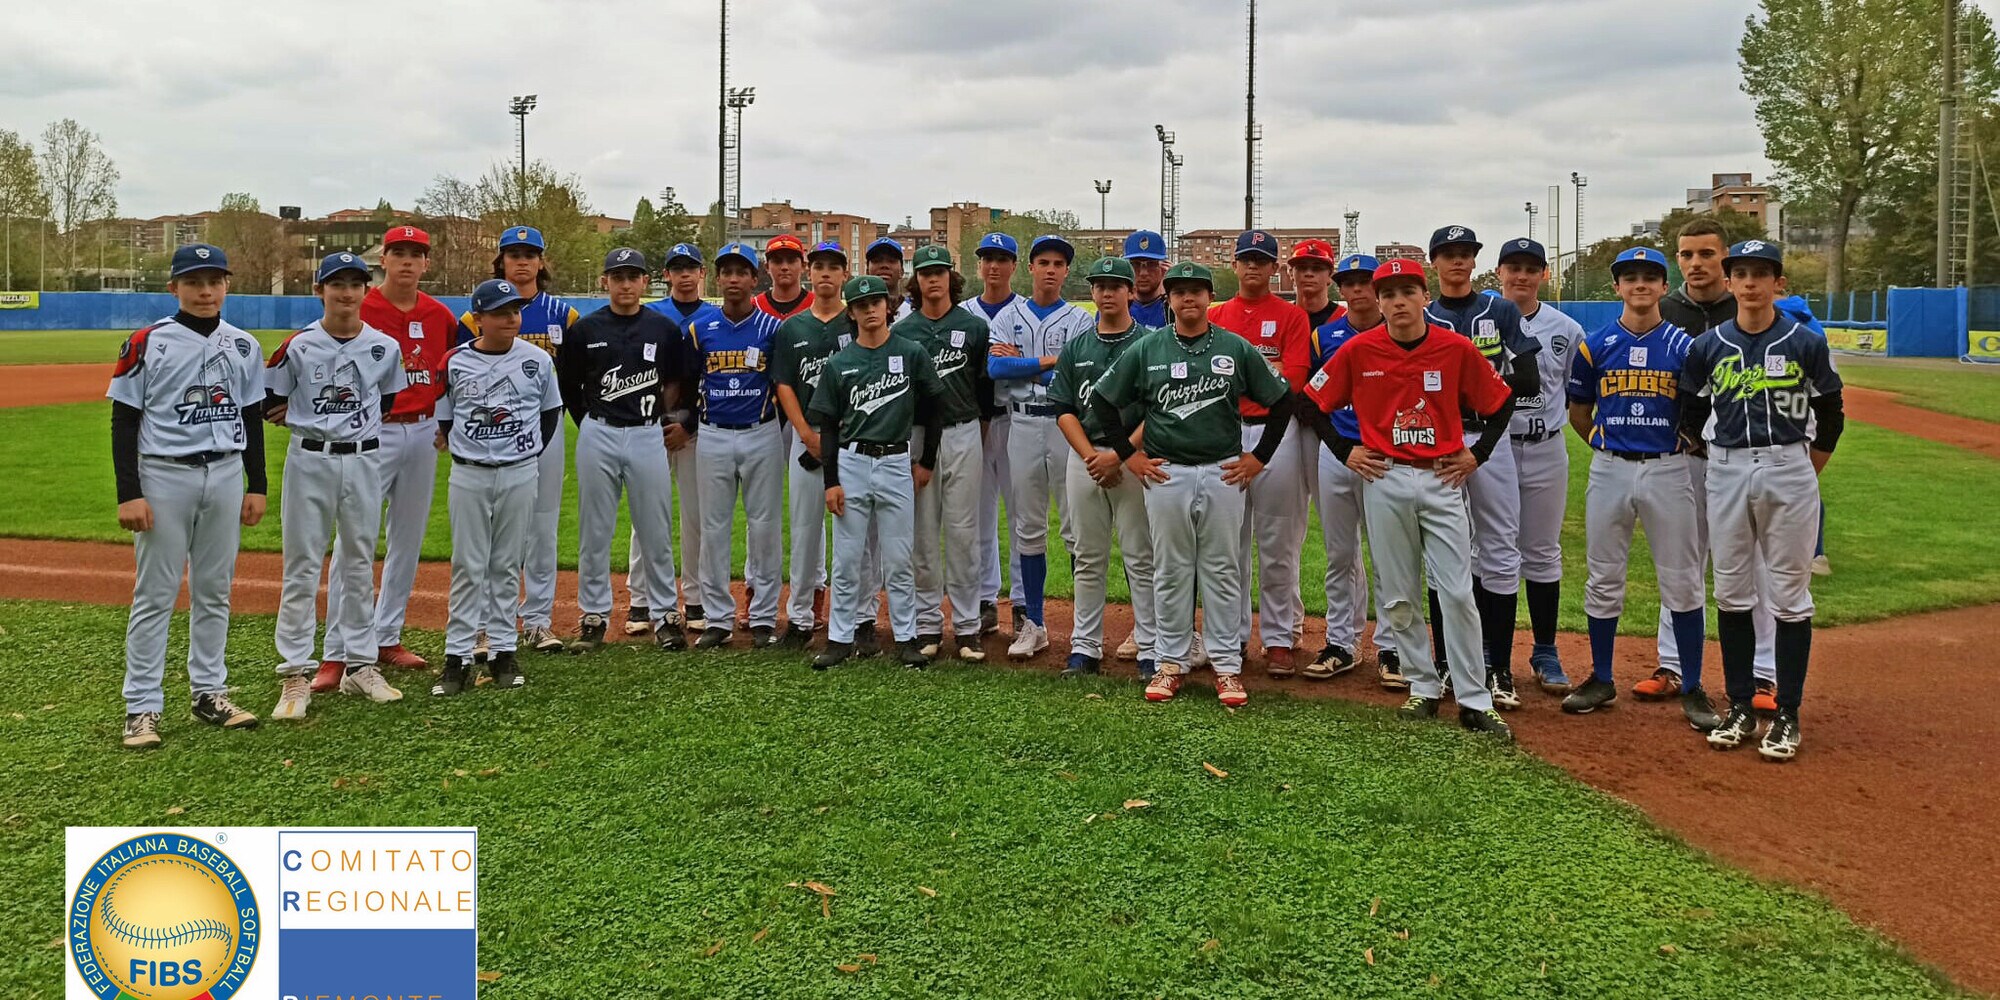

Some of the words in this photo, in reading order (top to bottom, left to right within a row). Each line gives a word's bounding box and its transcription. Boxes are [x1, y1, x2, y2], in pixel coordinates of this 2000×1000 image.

[405, 228, 414, 237] B
[1252, 233, 1265, 246] P
[1391, 262, 1401, 274] B
[1630, 349, 1645, 363] 16
[1767, 357, 1783, 371] 28
[314, 364, 323, 380] 6
[849, 373, 906, 410] Grizzlies
[1157, 375, 1226, 411] Grizzlies
[1601, 376, 1678, 400] CUBS
[640, 394, 657, 417] 17
[1773, 390, 1809, 420] 20
[1392, 427, 1436, 446] BOVES
